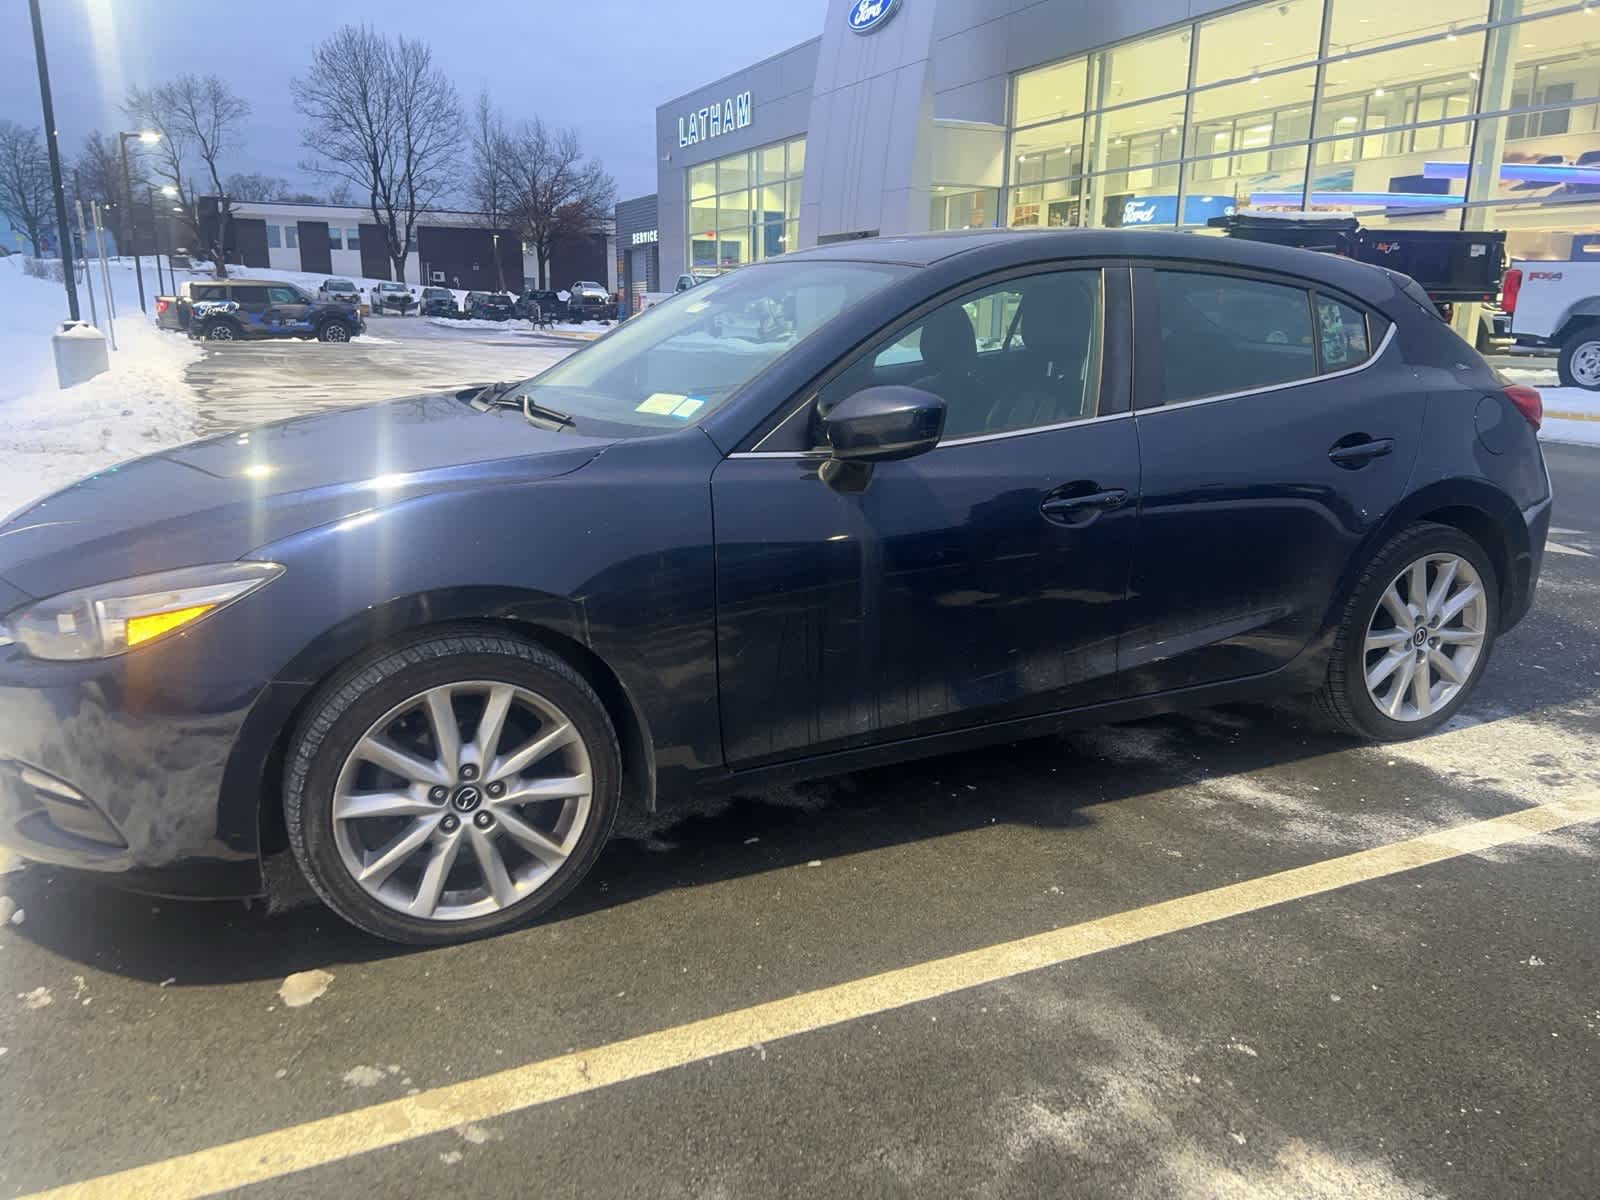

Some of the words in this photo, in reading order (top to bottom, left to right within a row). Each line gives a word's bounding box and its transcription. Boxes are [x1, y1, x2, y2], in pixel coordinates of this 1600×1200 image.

[678, 91, 751, 148] LATHAM
[1123, 201, 1156, 223] Ford
[632, 230, 658, 244] SERVICE
[198, 301, 230, 317] Ford
